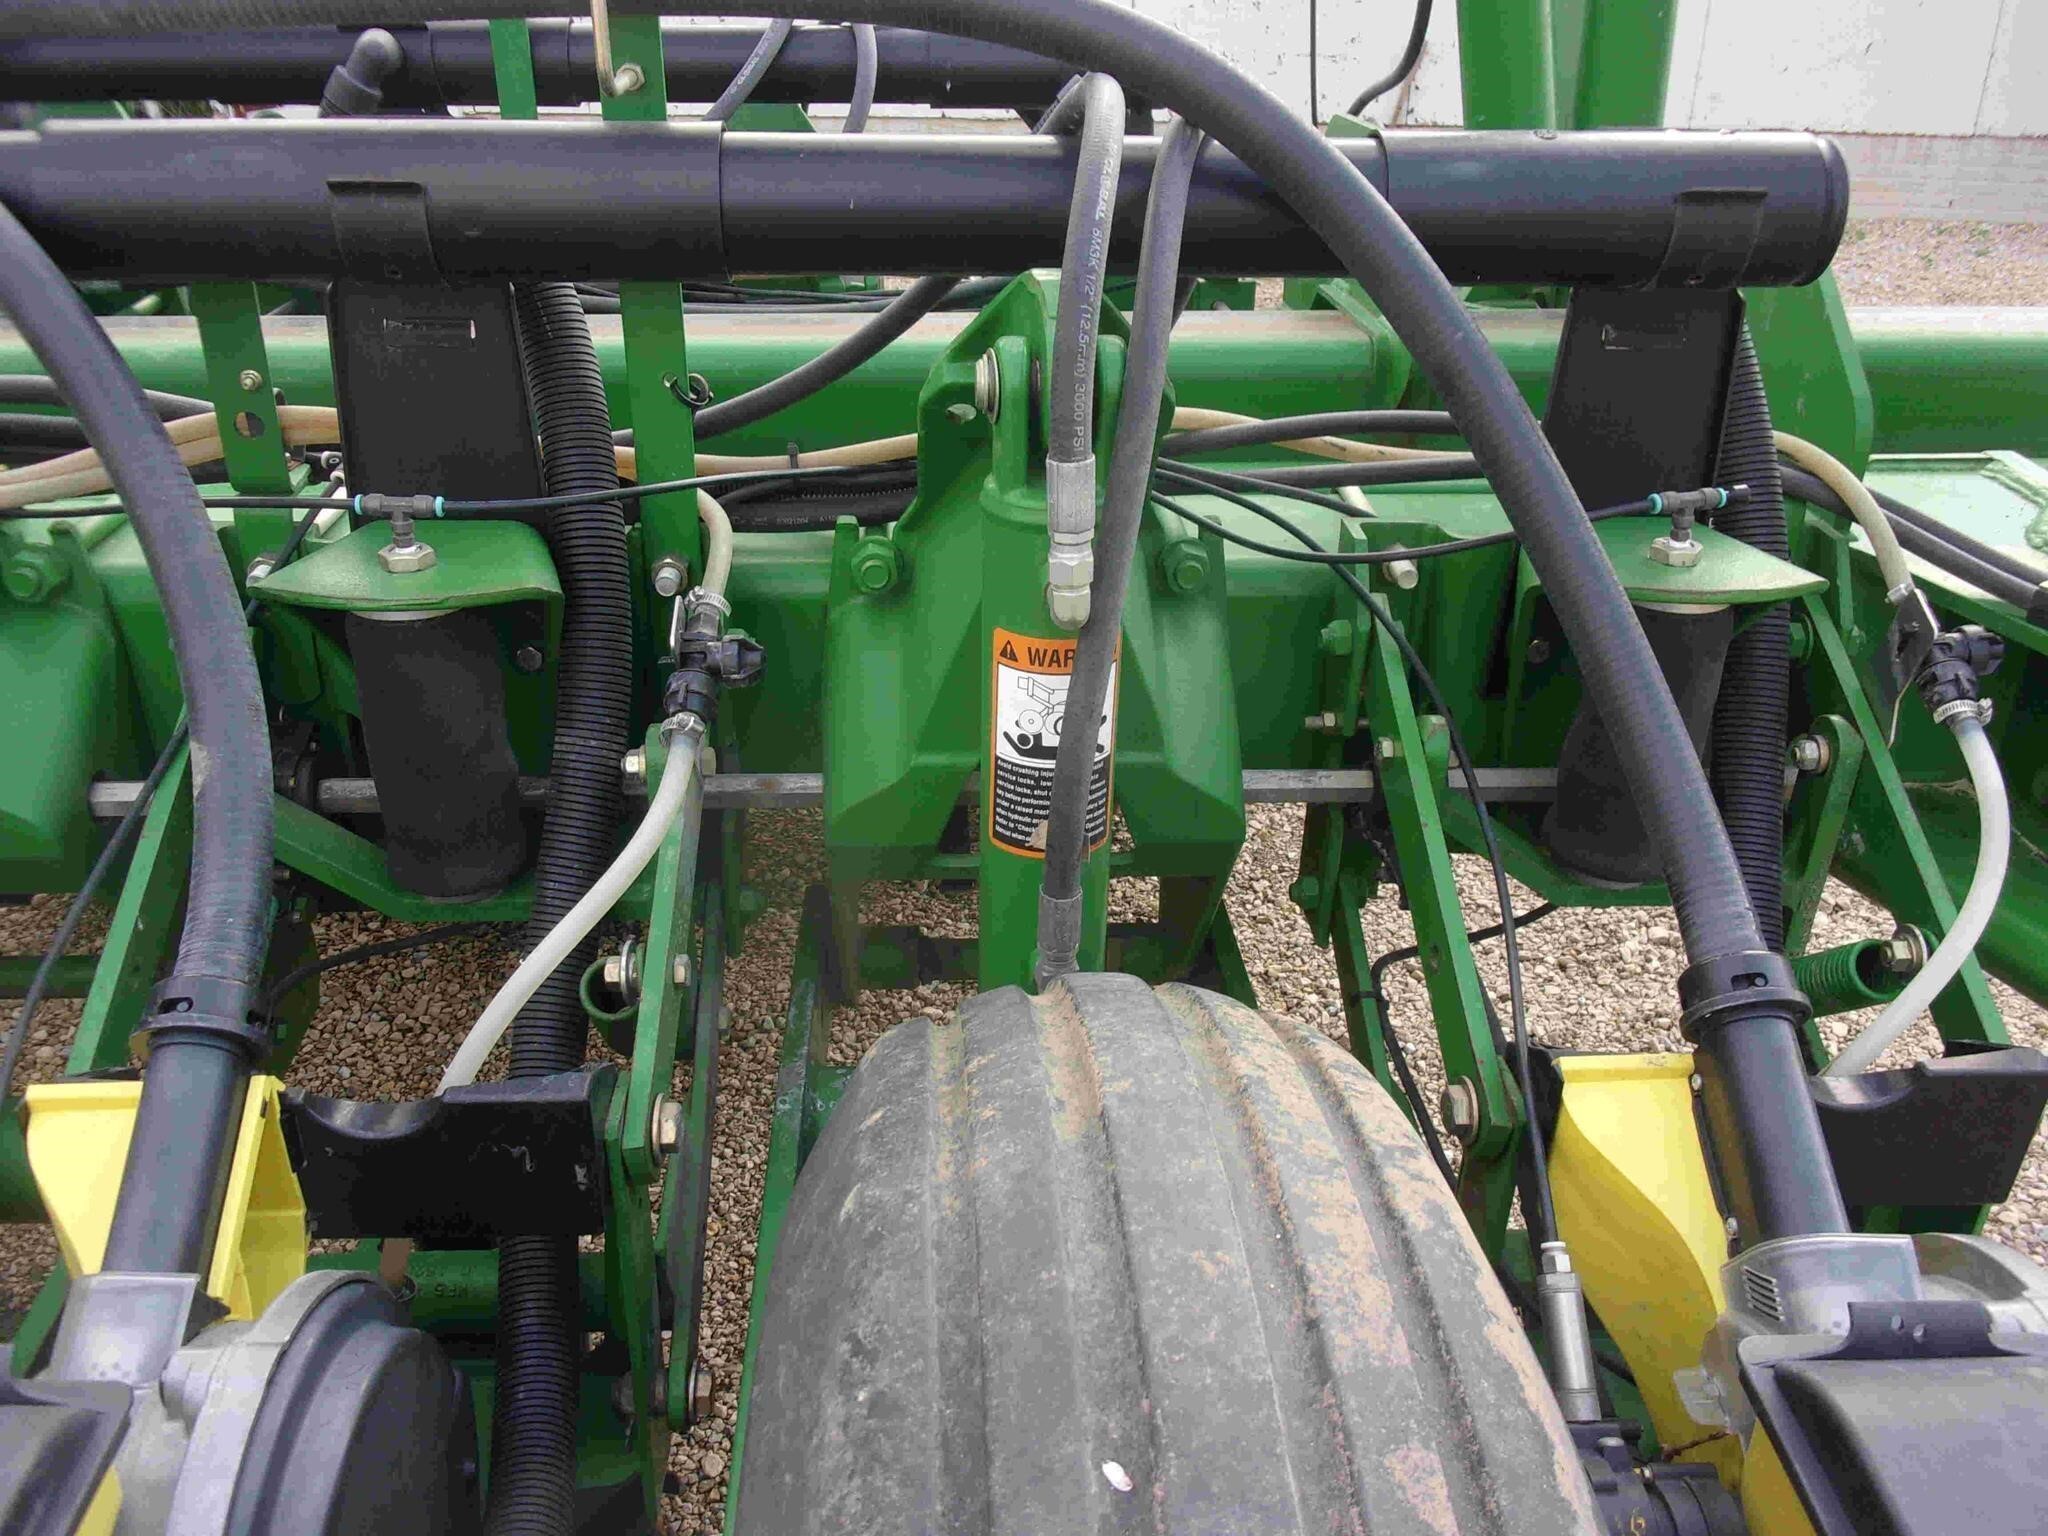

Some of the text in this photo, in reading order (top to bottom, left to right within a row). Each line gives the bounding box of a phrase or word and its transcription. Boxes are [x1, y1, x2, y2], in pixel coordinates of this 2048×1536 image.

[1073, 383, 1087, 421] 3000
[1072, 425, 1085, 452] PSI
[1012, 765, 1040, 777] crushing
[1021, 797, 1050, 806] performin
